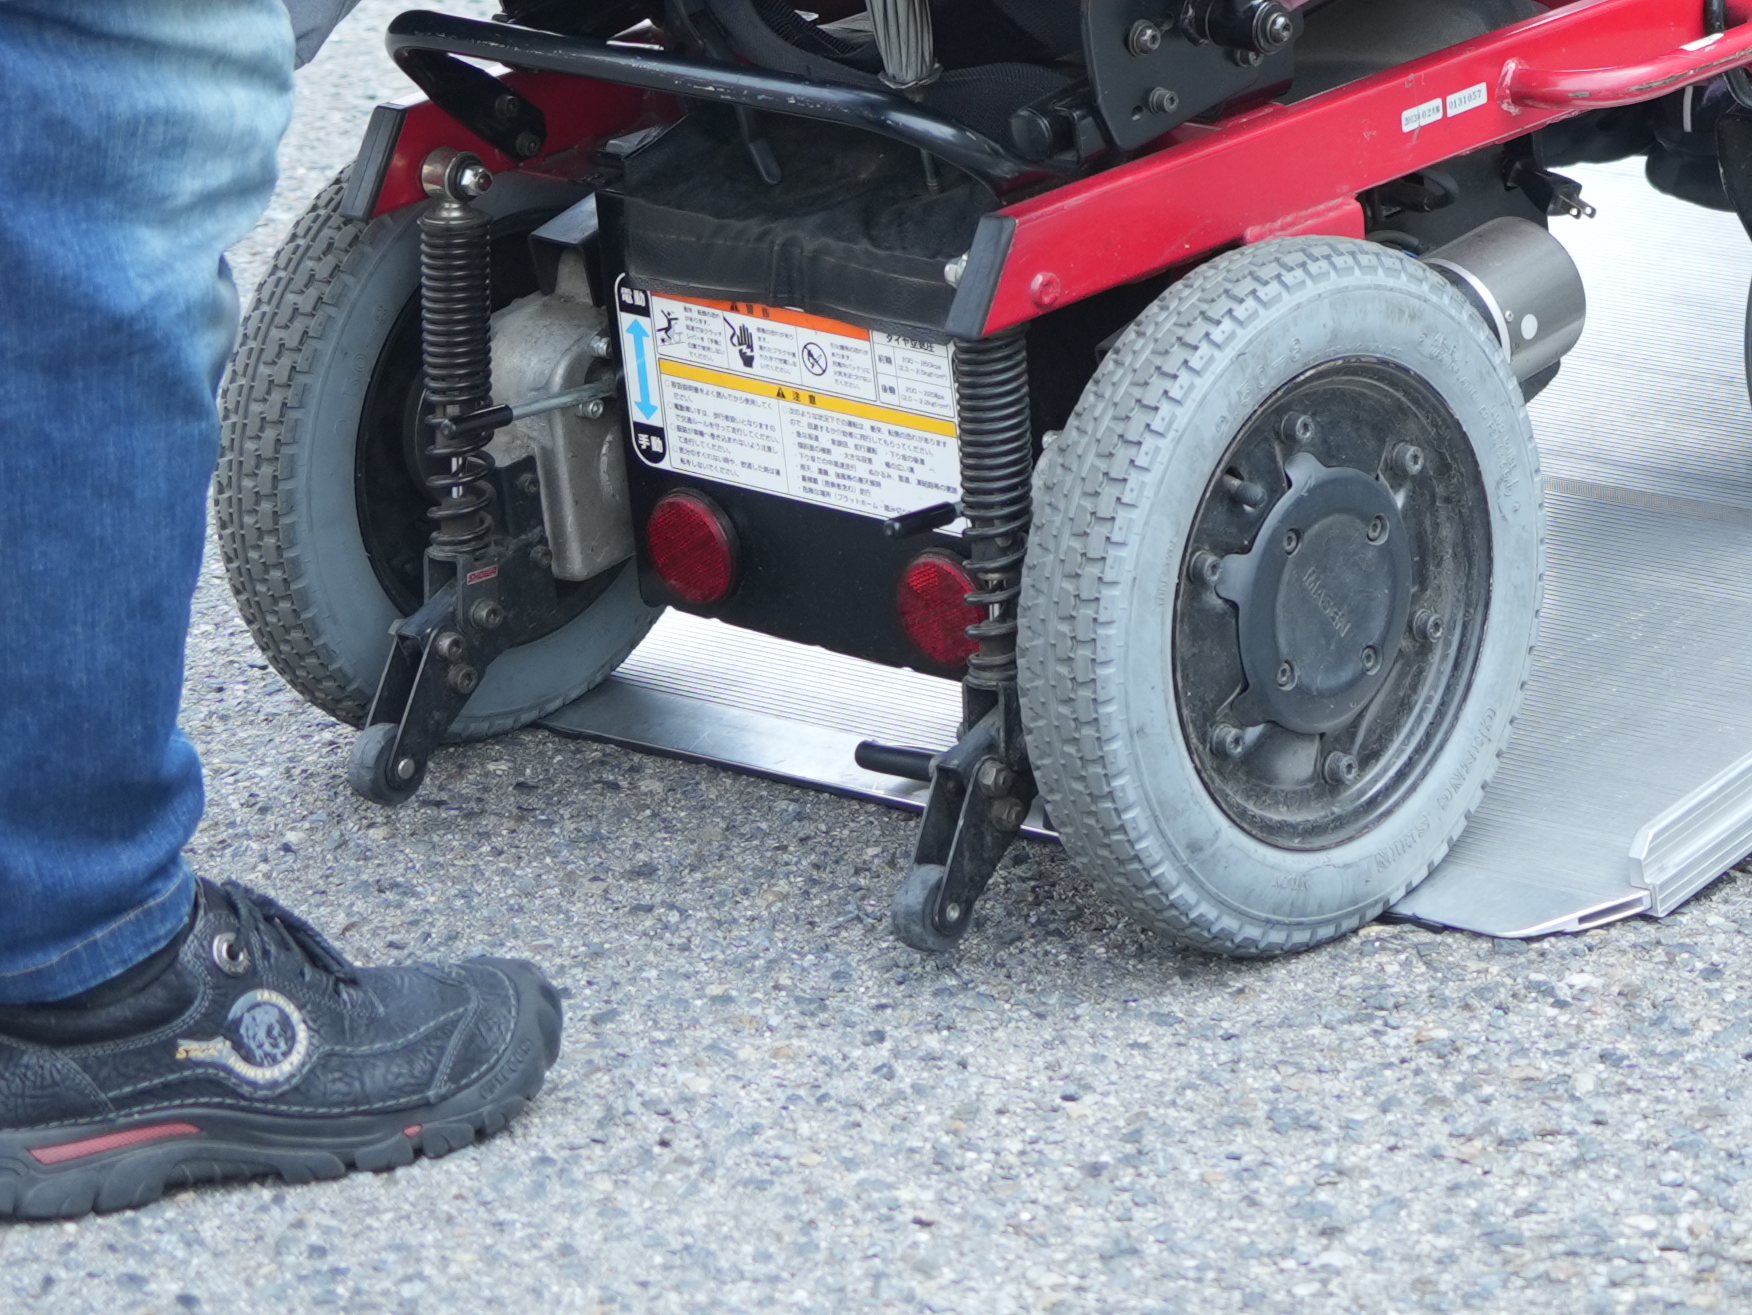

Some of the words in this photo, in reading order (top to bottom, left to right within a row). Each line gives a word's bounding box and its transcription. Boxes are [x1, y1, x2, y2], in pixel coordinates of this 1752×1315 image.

[1448, 89, 1482, 111] 0131057
[620, 286, 646, 307] 電動
[791, 390, 816, 405] 注意
[637, 434, 663, 454] 手動
